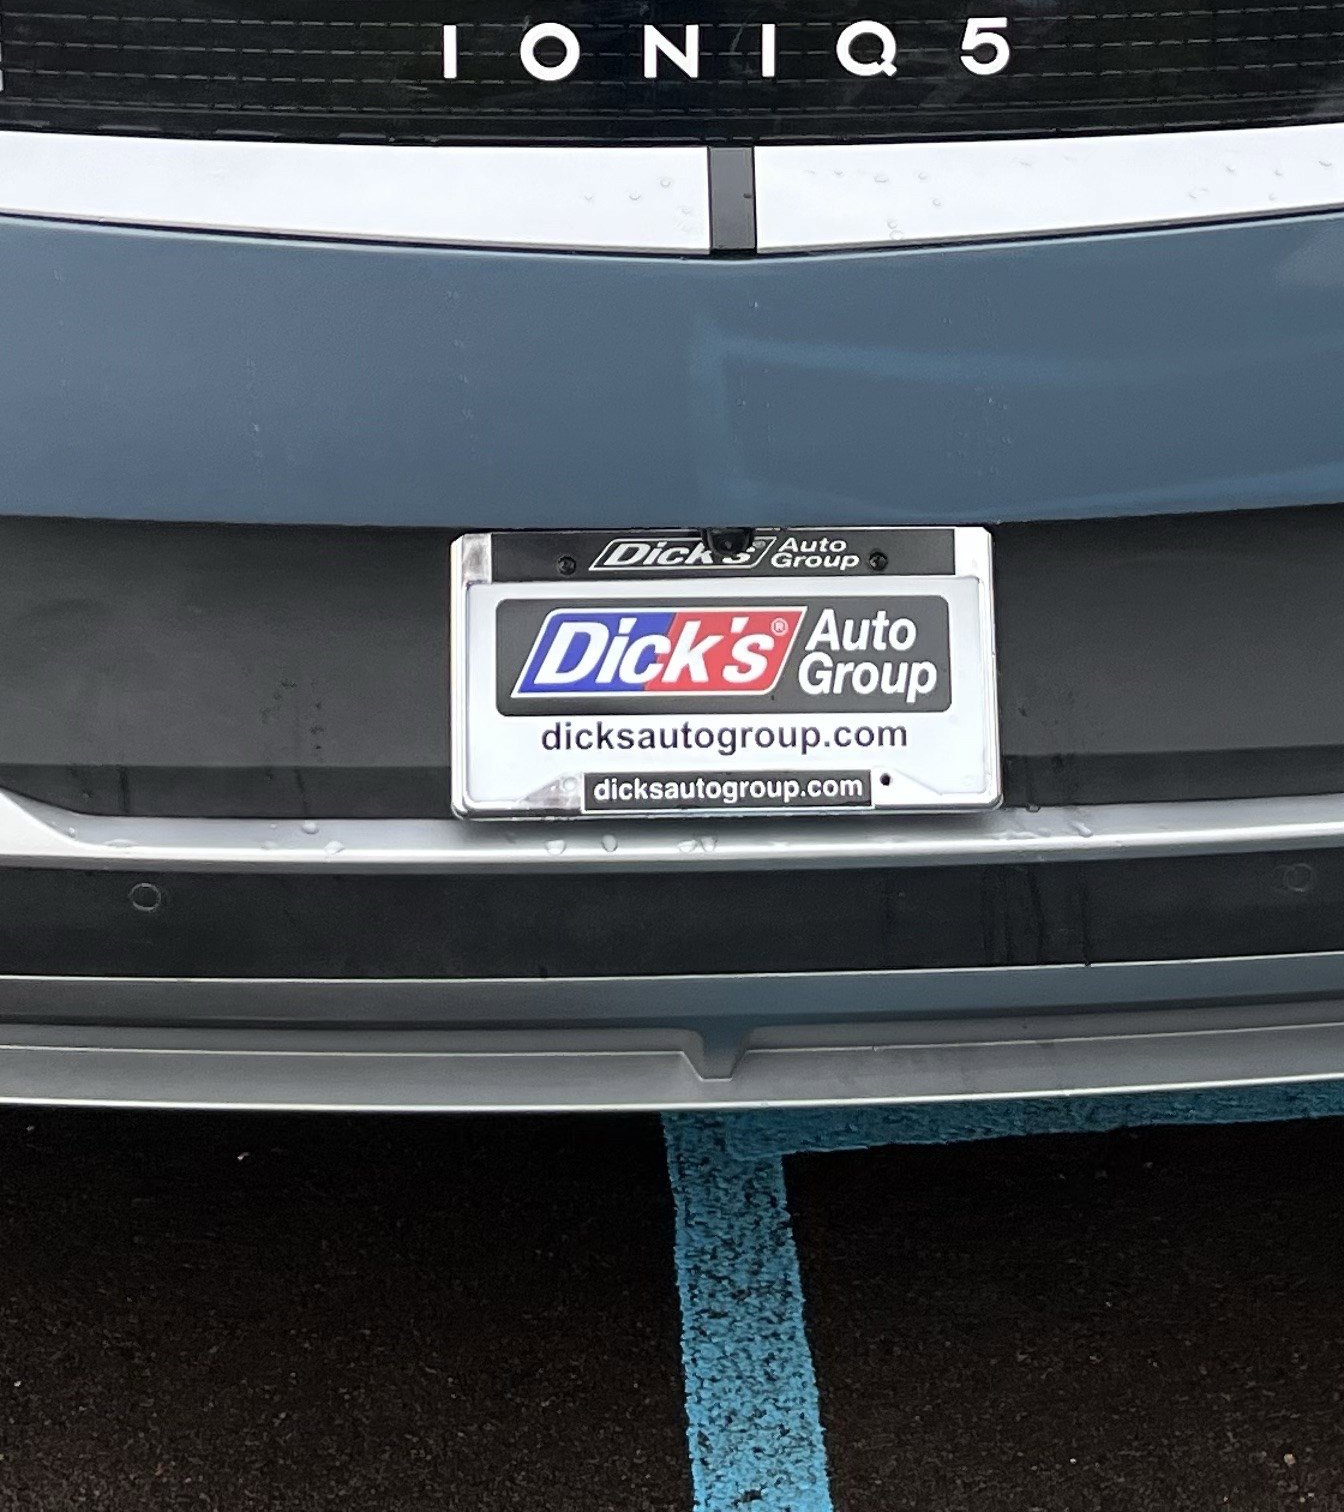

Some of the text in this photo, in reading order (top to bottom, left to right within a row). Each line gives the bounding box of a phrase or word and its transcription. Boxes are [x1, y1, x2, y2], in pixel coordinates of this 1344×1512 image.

[443, 17, 1011, 81] IONIQ 5
[770, 553, 860, 570] Group
[776, 537, 847, 553] Auto
[806, 608, 916, 652] Auto
[798, 654, 938, 703] Group
[541, 721, 908, 756] dicksautogroup.com
[593, 777, 863, 802] dicksautogroup.com
